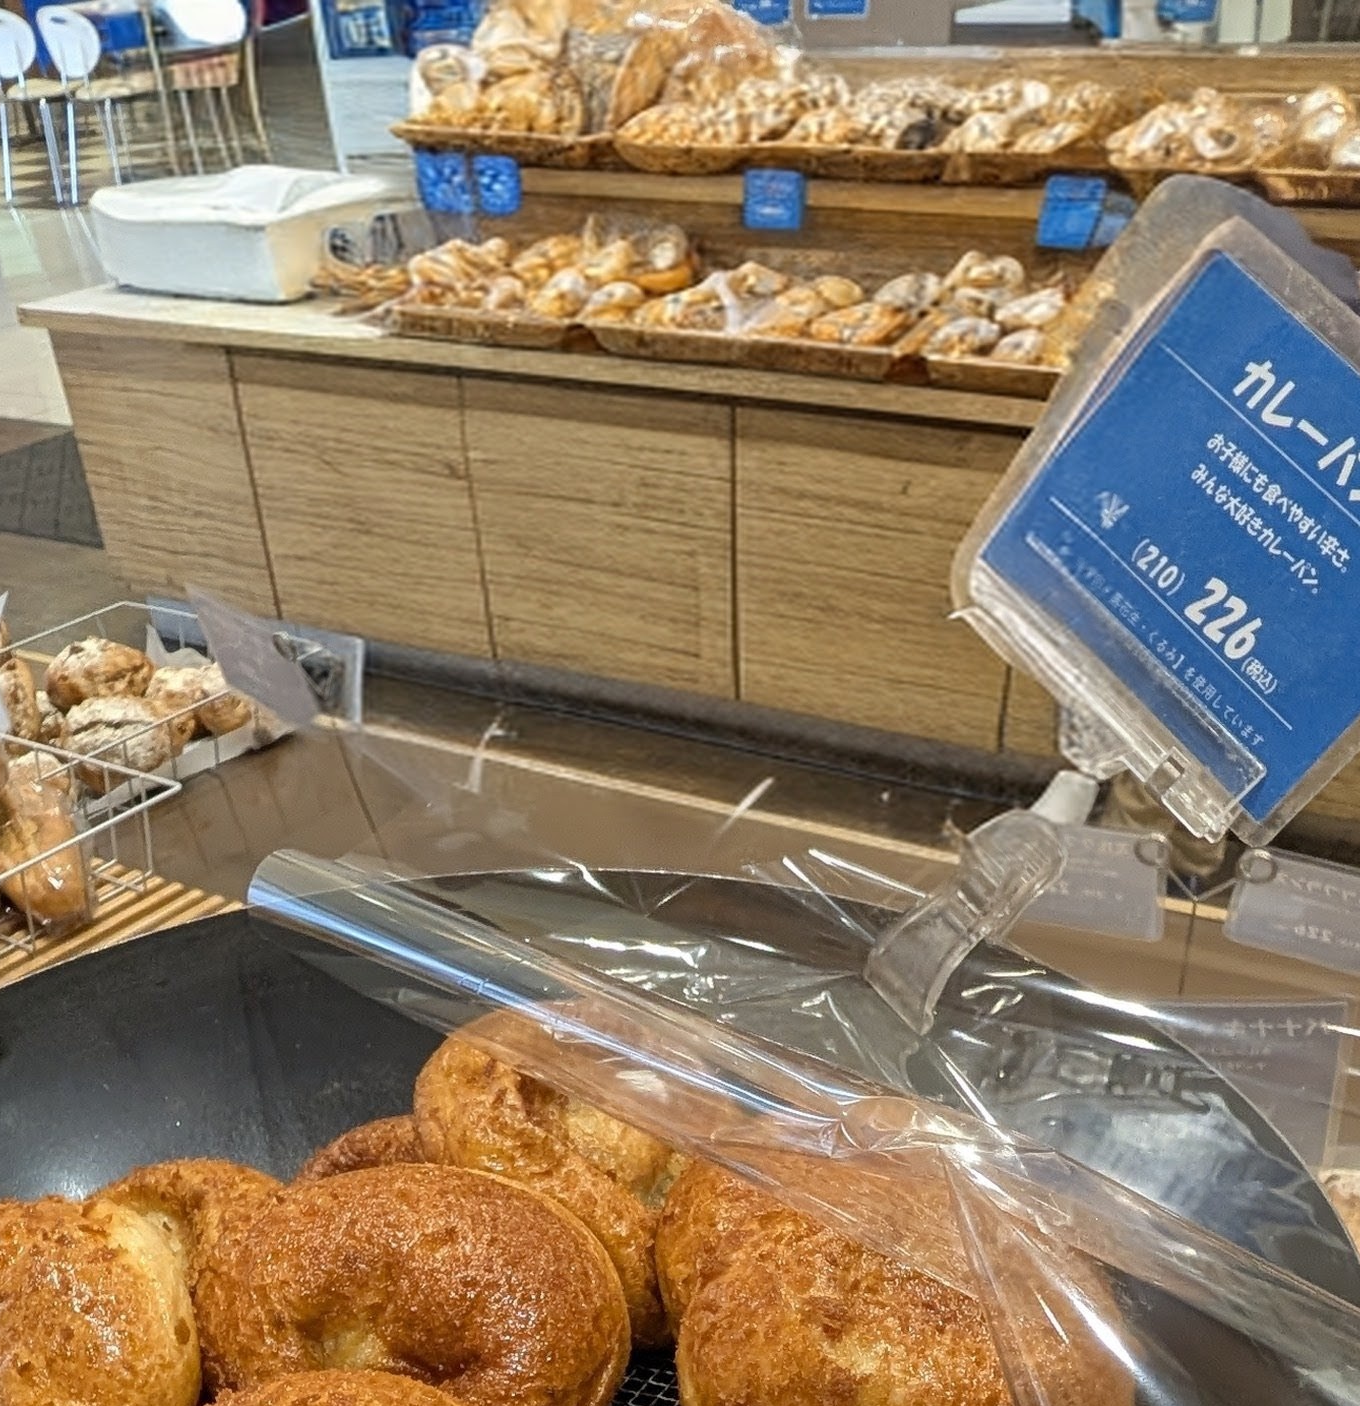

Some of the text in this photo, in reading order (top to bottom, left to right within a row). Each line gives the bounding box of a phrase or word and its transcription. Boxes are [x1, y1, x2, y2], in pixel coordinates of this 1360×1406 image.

[1191, 463, 1319, 595] みんな大好きカレーパン。
[1206, 433, 1351, 574] お子様にも食べやすい辛さ。
[1131, 537, 1186, 597] (210)
[1184, 577, 1264, 660] 226
